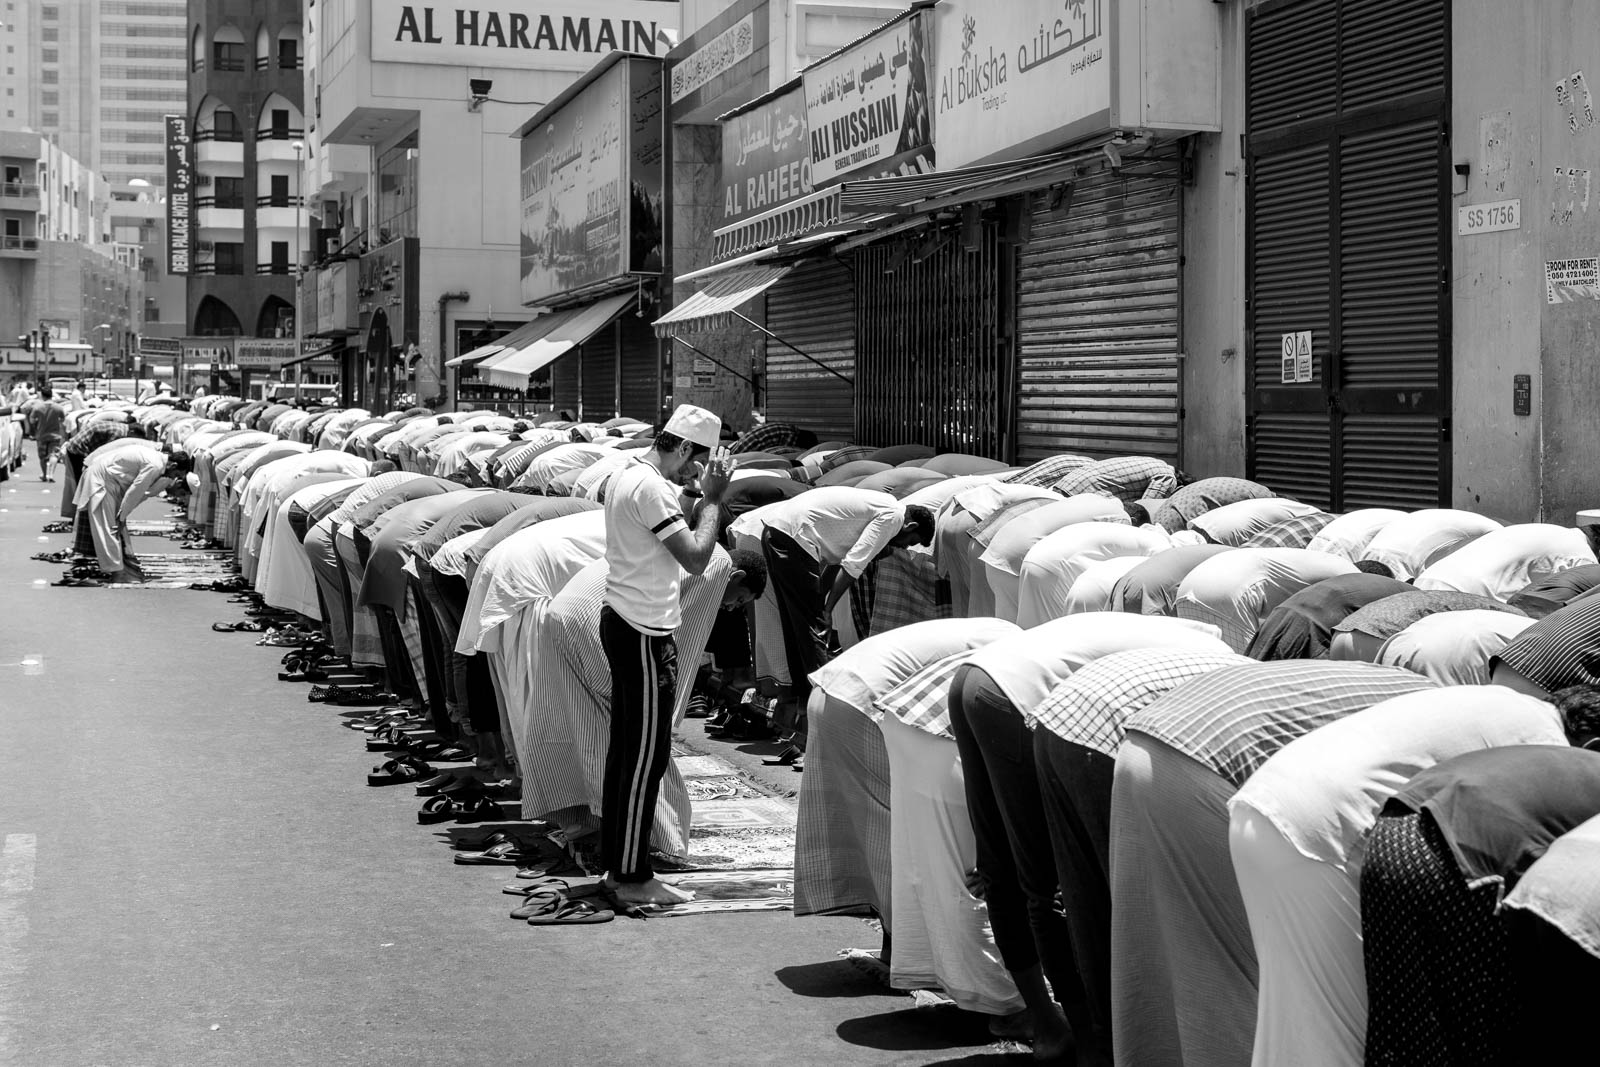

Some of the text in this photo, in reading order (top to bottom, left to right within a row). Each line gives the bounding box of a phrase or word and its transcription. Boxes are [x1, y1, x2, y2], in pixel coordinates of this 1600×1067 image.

[395, 6, 657, 55] AL HARAMAIN
[858, 51, 885, 102] حسيني
[940, 46, 1007, 114] Al Buksha
[811, 93, 899, 164] ALI HUSSAINI
[170, 145, 189, 167] قصر
[834, 153, 851, 171] GENERAL
[850, 149, 868, 167] TRADING
[724, 184, 742, 218] AL
[747, 157, 812, 211] RAHEEQ
[172, 192, 189, 272] DEIRA PALACE HOTEL
[1468, 205, 1514, 228] SS 1756
[1550, 259, 1593, 271] ROOM FOR RENT
[1551, 270, 1594, 279] 050 4721400
